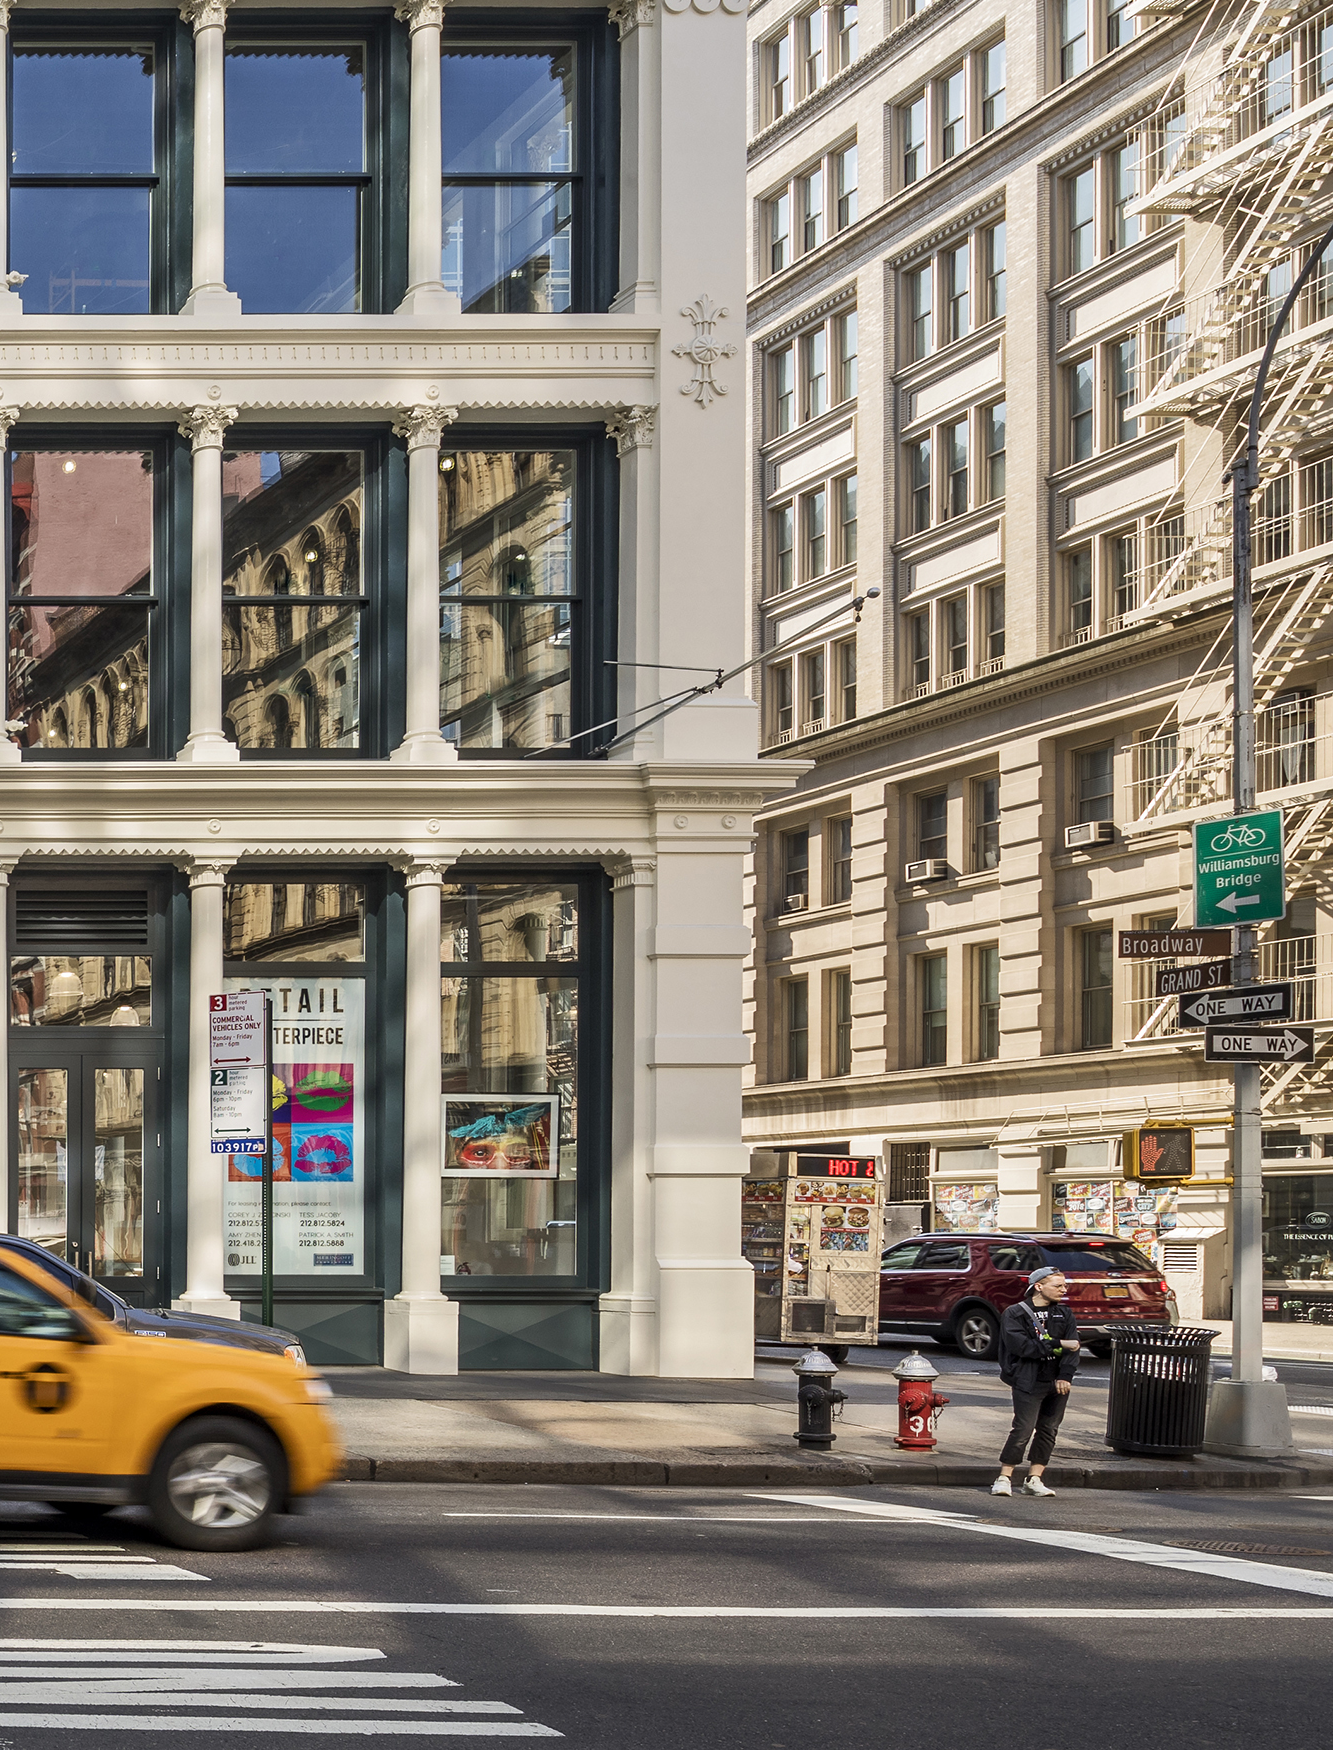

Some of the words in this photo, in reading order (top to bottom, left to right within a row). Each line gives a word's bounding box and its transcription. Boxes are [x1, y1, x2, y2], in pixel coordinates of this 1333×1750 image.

[1198, 854, 1280, 874] Williamsburg
[1216, 874, 1261, 888] Bridge
[1122, 935, 1203, 956] Broadway
[1161, 970, 1202, 994] GRAND
[1208, 964, 1223, 986] ST
[214, 996, 223, 1010] 3
[240, 988, 344, 1012] TAIL
[1196, 1001, 1226, 1016] ONE
[1242, 996, 1276, 1012] WAY
[213, 1015, 254, 1023] COMMERCIAL
[274, 1028, 343, 1044] TERPIECE
[1222, 1038, 1252, 1050] ONE
[1266, 1038, 1298, 1052] WAY
[215, 1071, 223, 1084] 2
[213, 1143, 252, 1152] 103917
[828, 1160, 859, 1176] HOT
[241, 1256, 256, 1264] JLL
